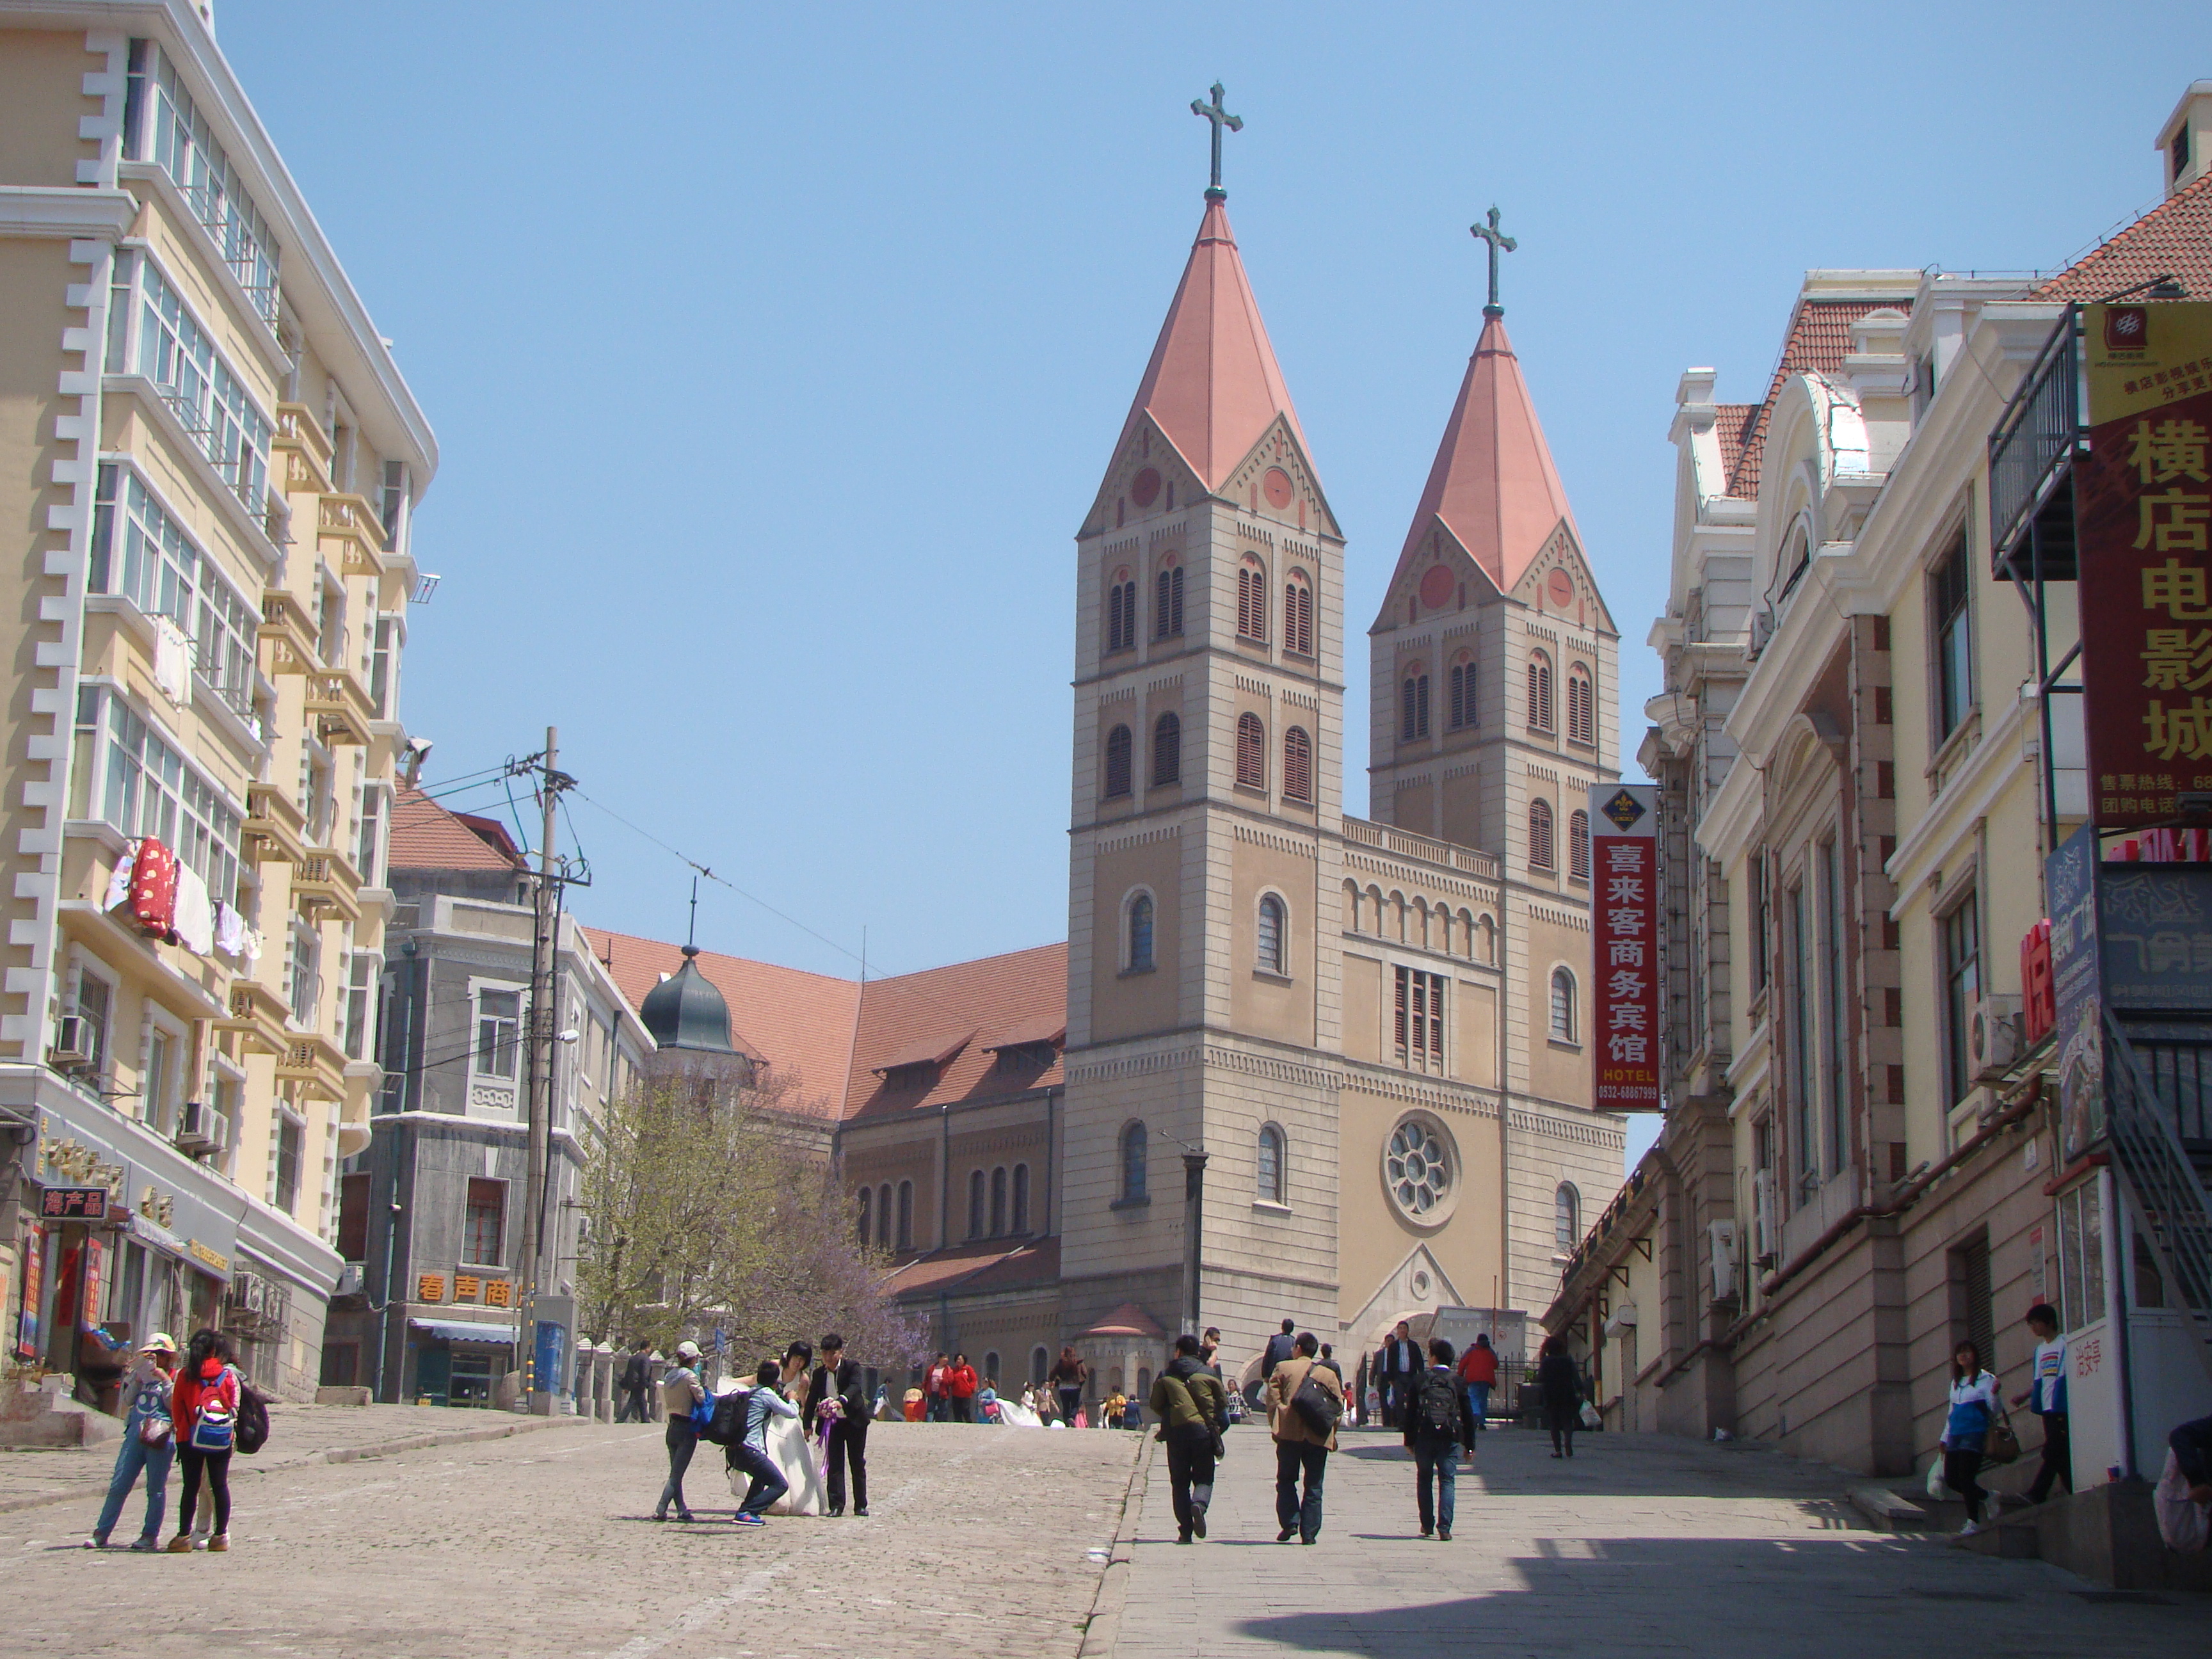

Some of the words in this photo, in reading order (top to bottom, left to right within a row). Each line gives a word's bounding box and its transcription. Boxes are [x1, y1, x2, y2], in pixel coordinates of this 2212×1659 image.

[2128, 419, 2212, 762] 横店电影城
[1607, 844, 1647, 1063] 喜来客商务宾馆
[1603, 1068, 1655, 1082] HOTEL
[1598, 1085, 1656, 1100] 0532-68867999
[44, 1190, 102, 1215] 海产品
[419, 1273, 524, 1307] 春声商
[2076, 1338, 2102, 1379] 治安亭
